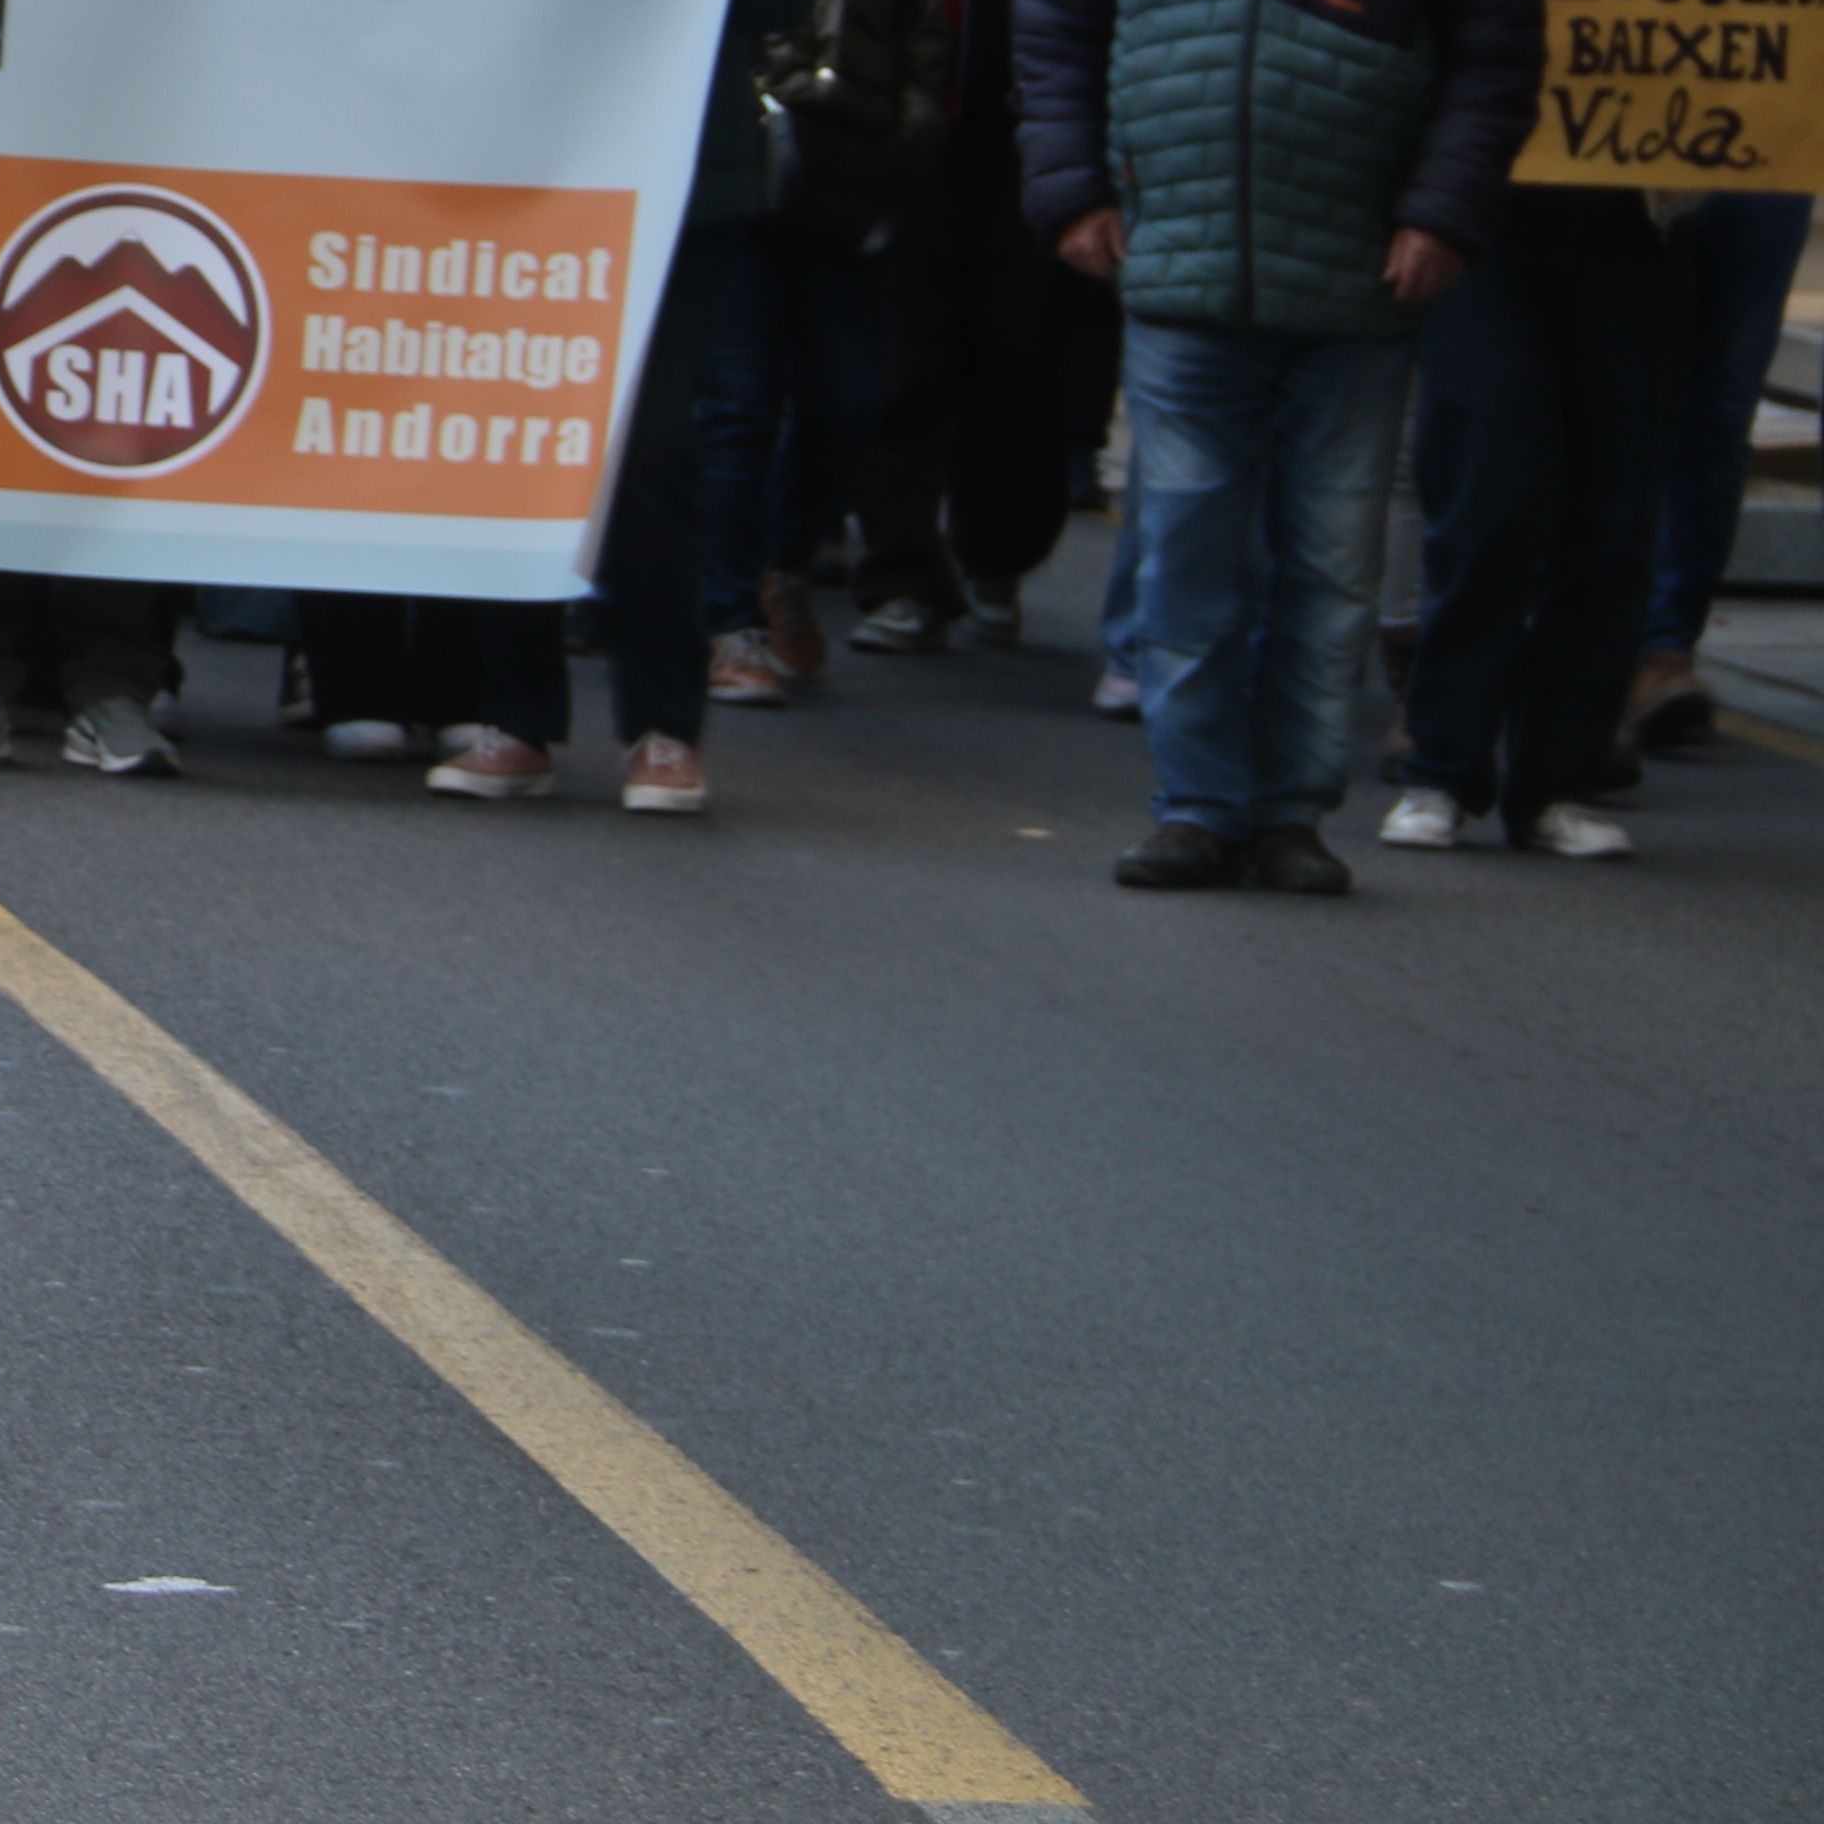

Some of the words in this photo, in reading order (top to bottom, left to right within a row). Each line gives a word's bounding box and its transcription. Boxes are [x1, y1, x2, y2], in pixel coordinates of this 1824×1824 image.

[1565, 15, 1790, 82] BAIXEN
[307, 231, 613, 302] Sindicat
[45, 344, 194, 429] SHA
[300, 314, 602, 389] Habitatge
[291, 396, 592, 467] Andorra
